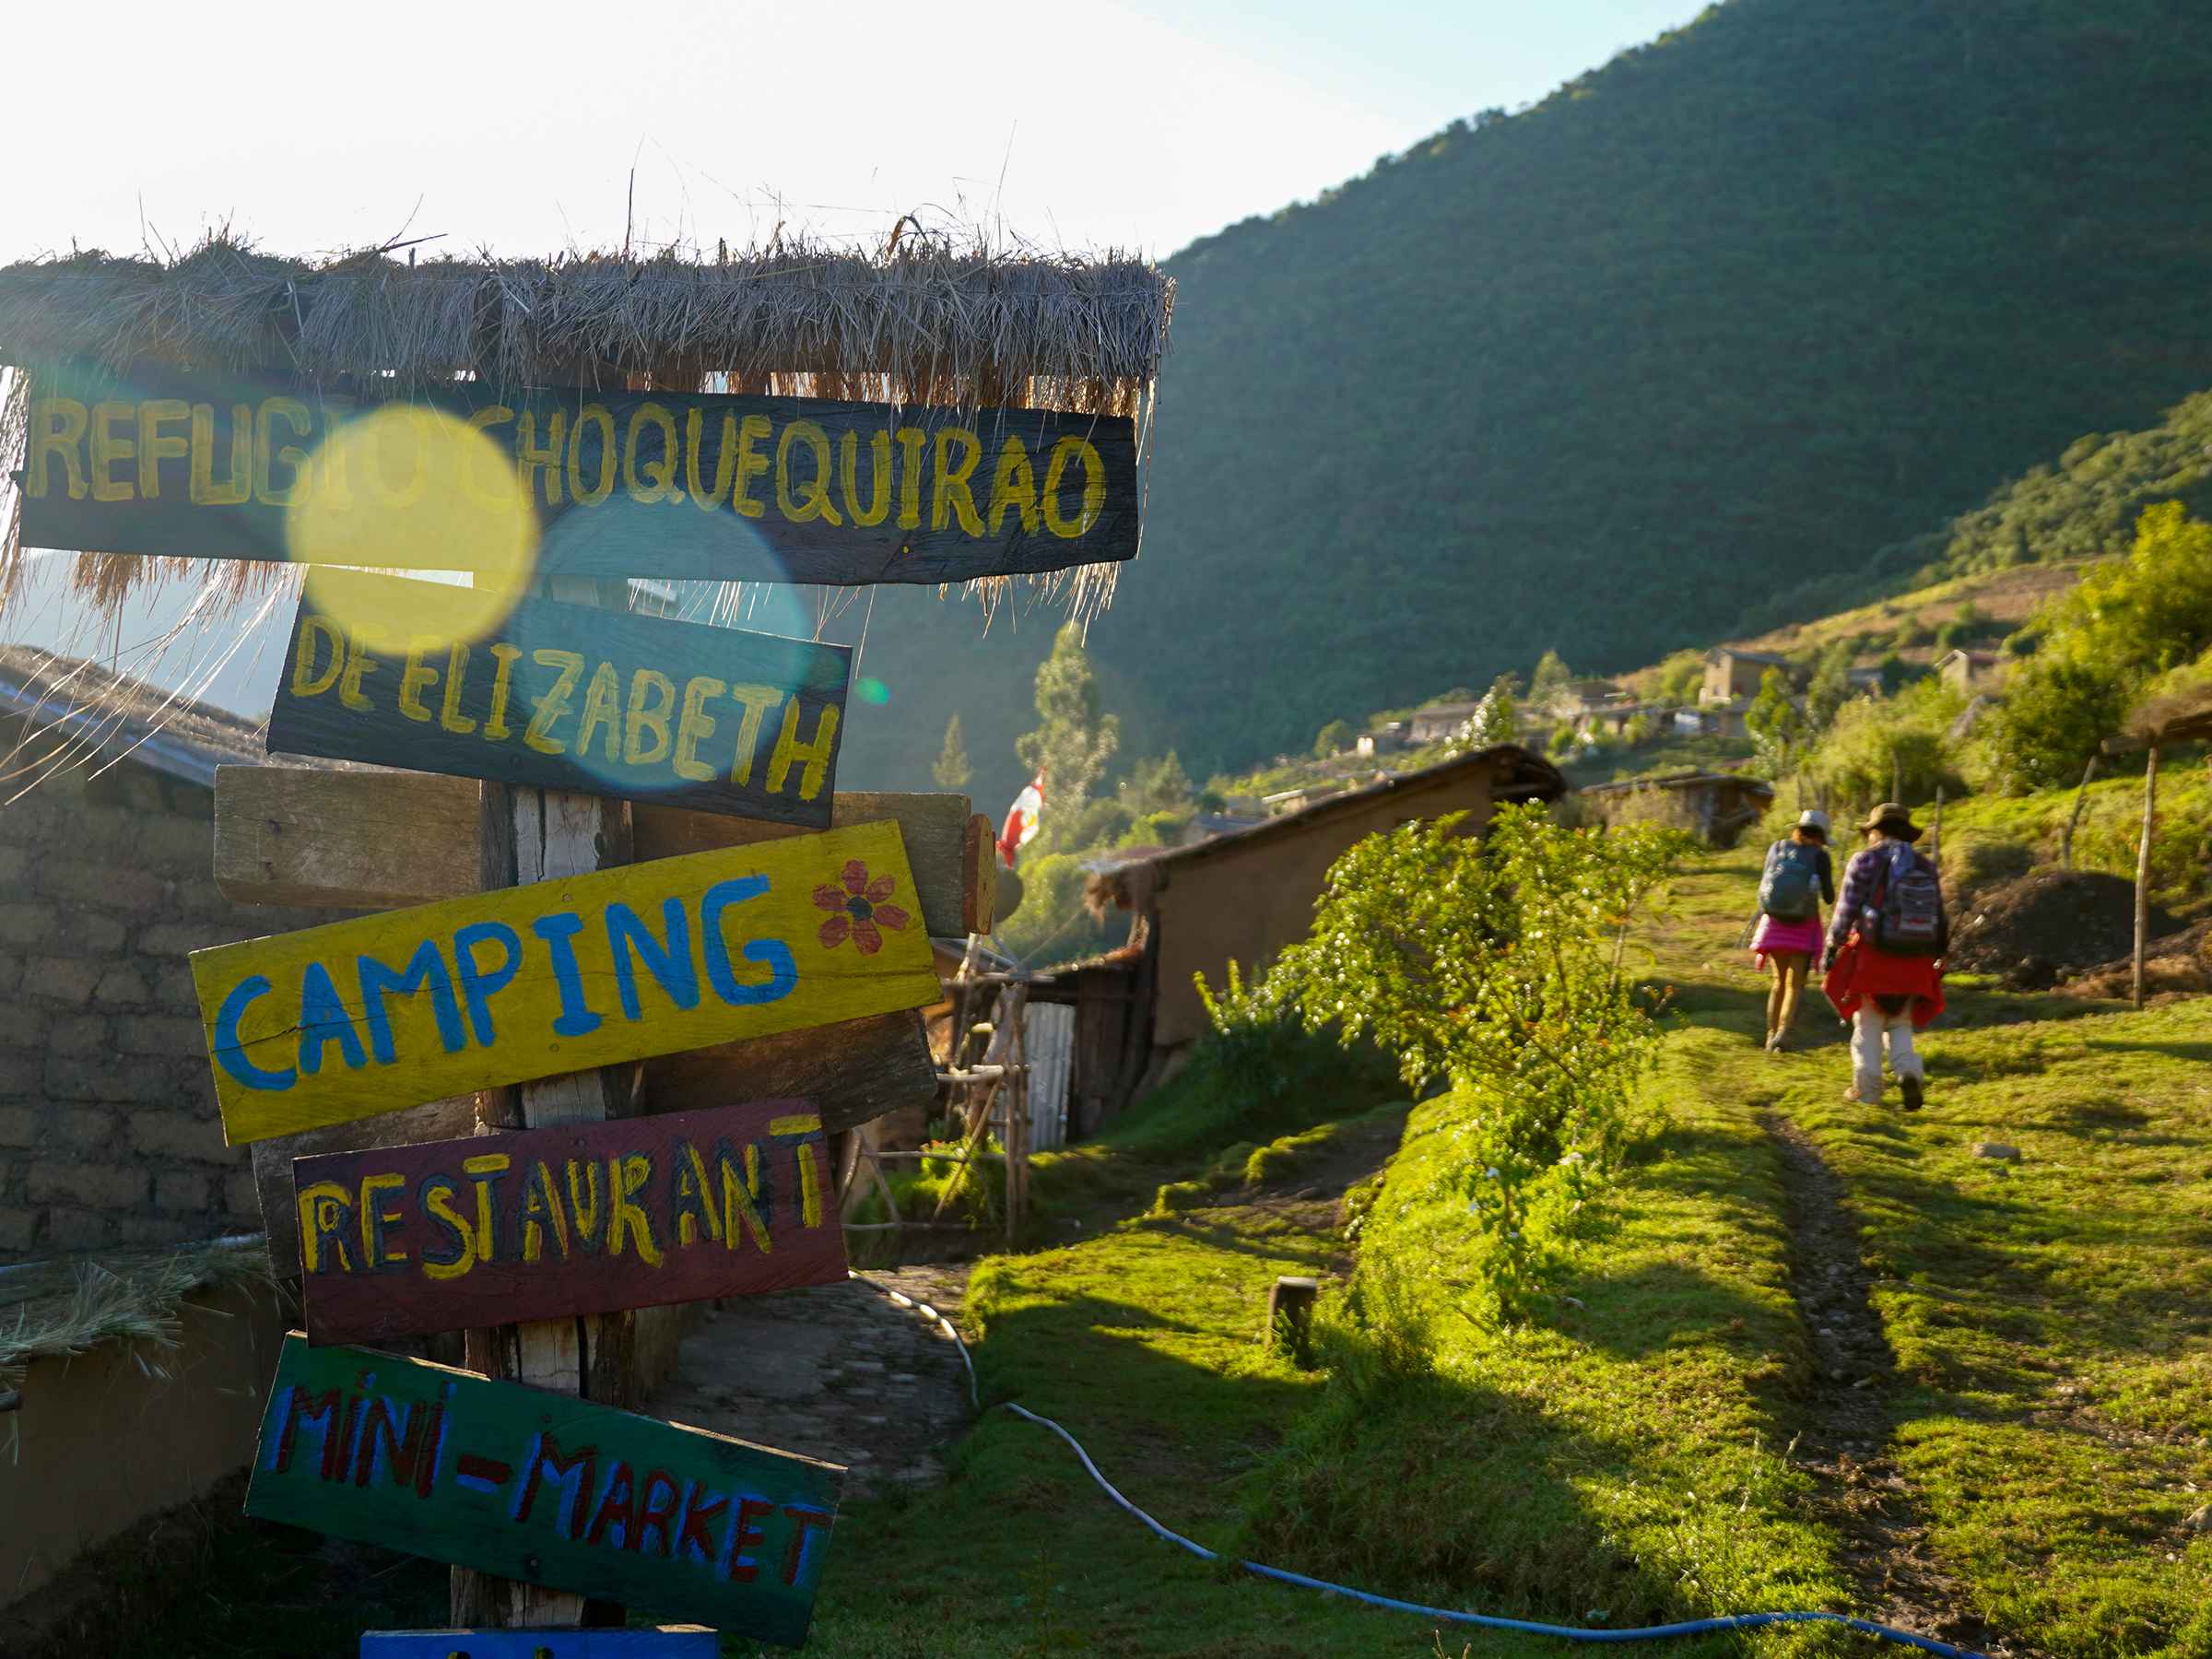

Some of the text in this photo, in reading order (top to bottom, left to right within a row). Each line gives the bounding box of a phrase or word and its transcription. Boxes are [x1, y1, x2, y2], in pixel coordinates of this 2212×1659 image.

[25, 396, 1106, 540] REFUGIO CHOQUEQUIRAO
[290, 616, 840, 802] DE ELIZABETH
[214, 874, 798, 1090] CAMPING
[298, 1113, 824, 1280] RESTAURANT
